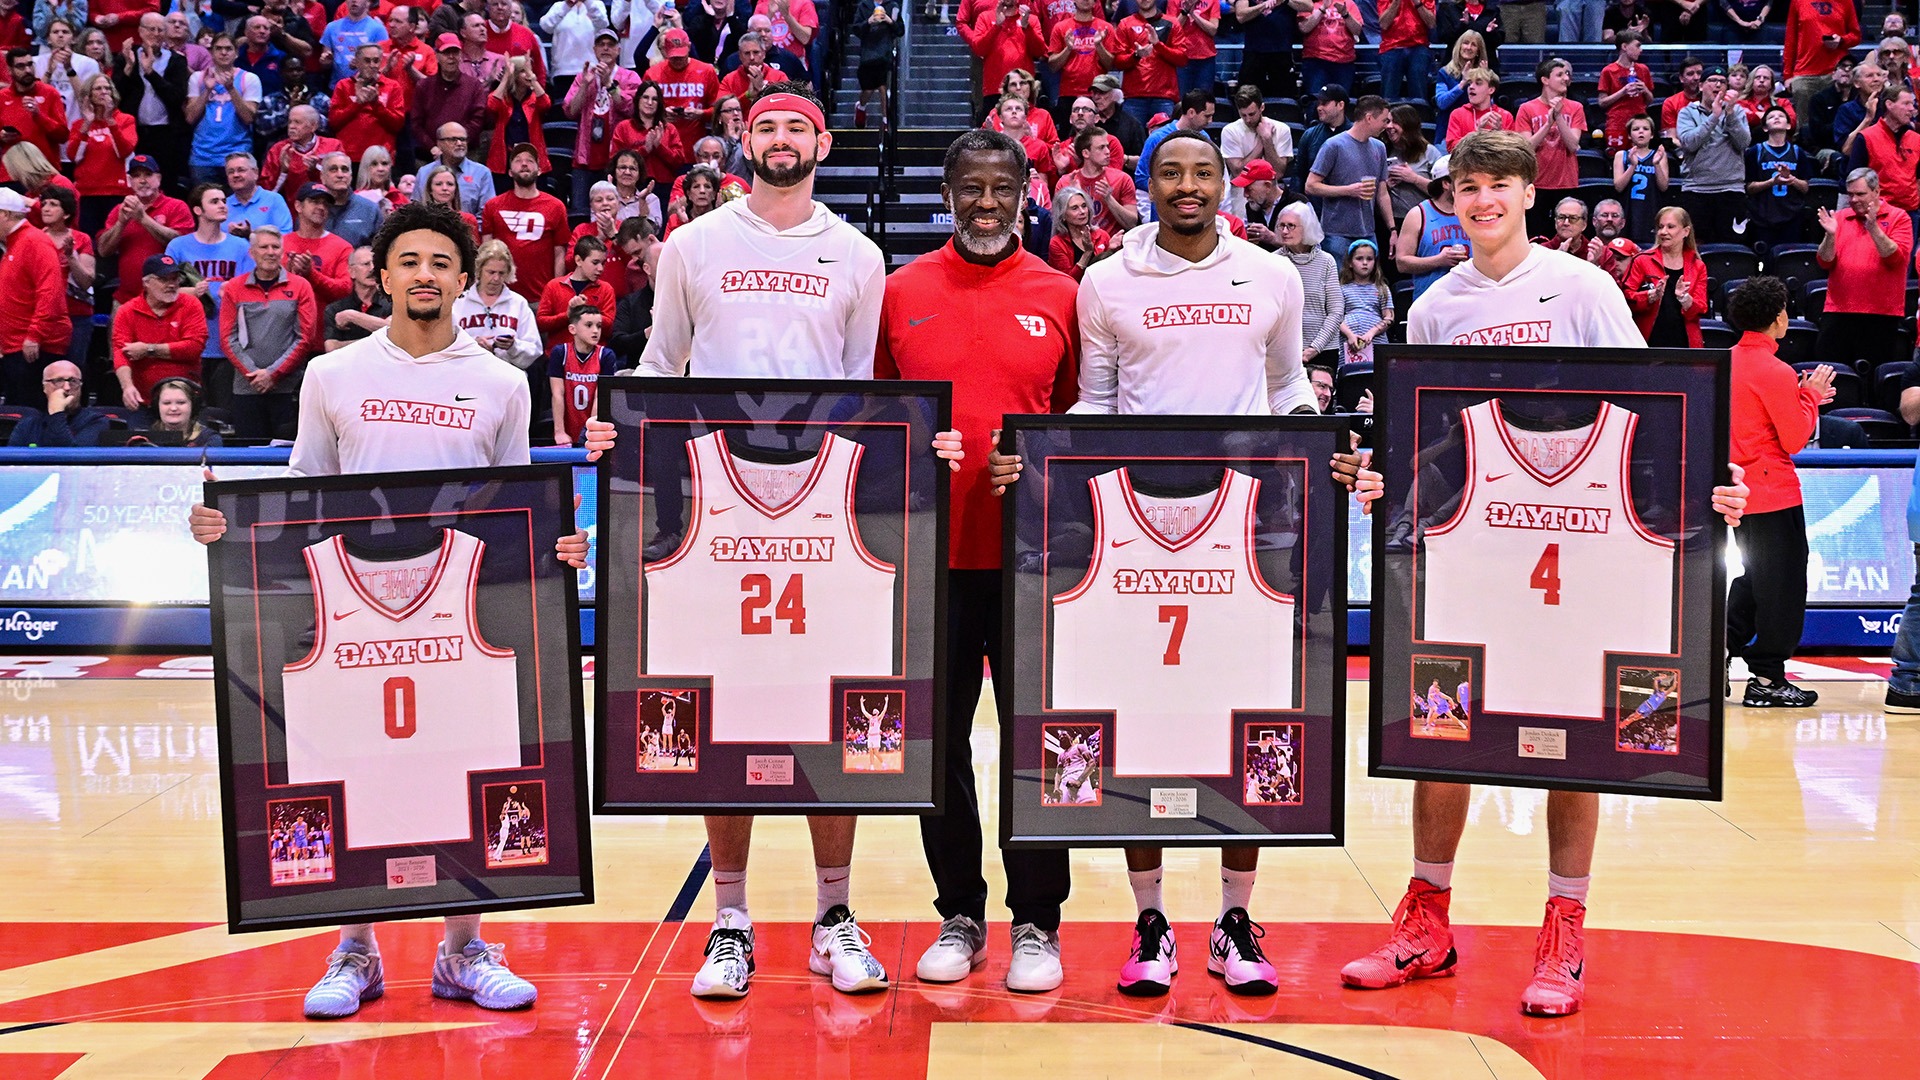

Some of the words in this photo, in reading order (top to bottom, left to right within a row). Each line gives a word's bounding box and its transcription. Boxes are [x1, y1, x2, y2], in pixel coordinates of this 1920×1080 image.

[215, 106, 222, 122] 1
[1631, 173, 1648, 200] 2
[931, 213, 954, 225] 105
[187, 260, 237, 281] AYTON
[720, 270, 829, 298] DAYTON
[460, 313, 519, 328] DAYTON
[1143, 303, 1252, 329] DAYTON
[566, 371, 599, 383] DAYTON
[573, 384, 590, 411] 0
[360, 399, 475, 430] DAYTON
[159, 484, 204, 502] OVE
[83, 505, 110, 524] 50
[114, 505, 179, 524] YEARS
[1485, 501, 1611, 534] DAYTON
[710, 536, 835, 562] DAYTON
[0, 565, 50, 589] AN
[1113, 569, 1235, 594] DAYTON
[1530, 543, 1561, 605] 4
[741, 573, 806, 635] 24
[6, 611, 59, 641] Kroger
[1158, 605, 1188, 665] 7
[333, 635, 463, 669] DAYTON
[383, 676, 416, 739] 0
